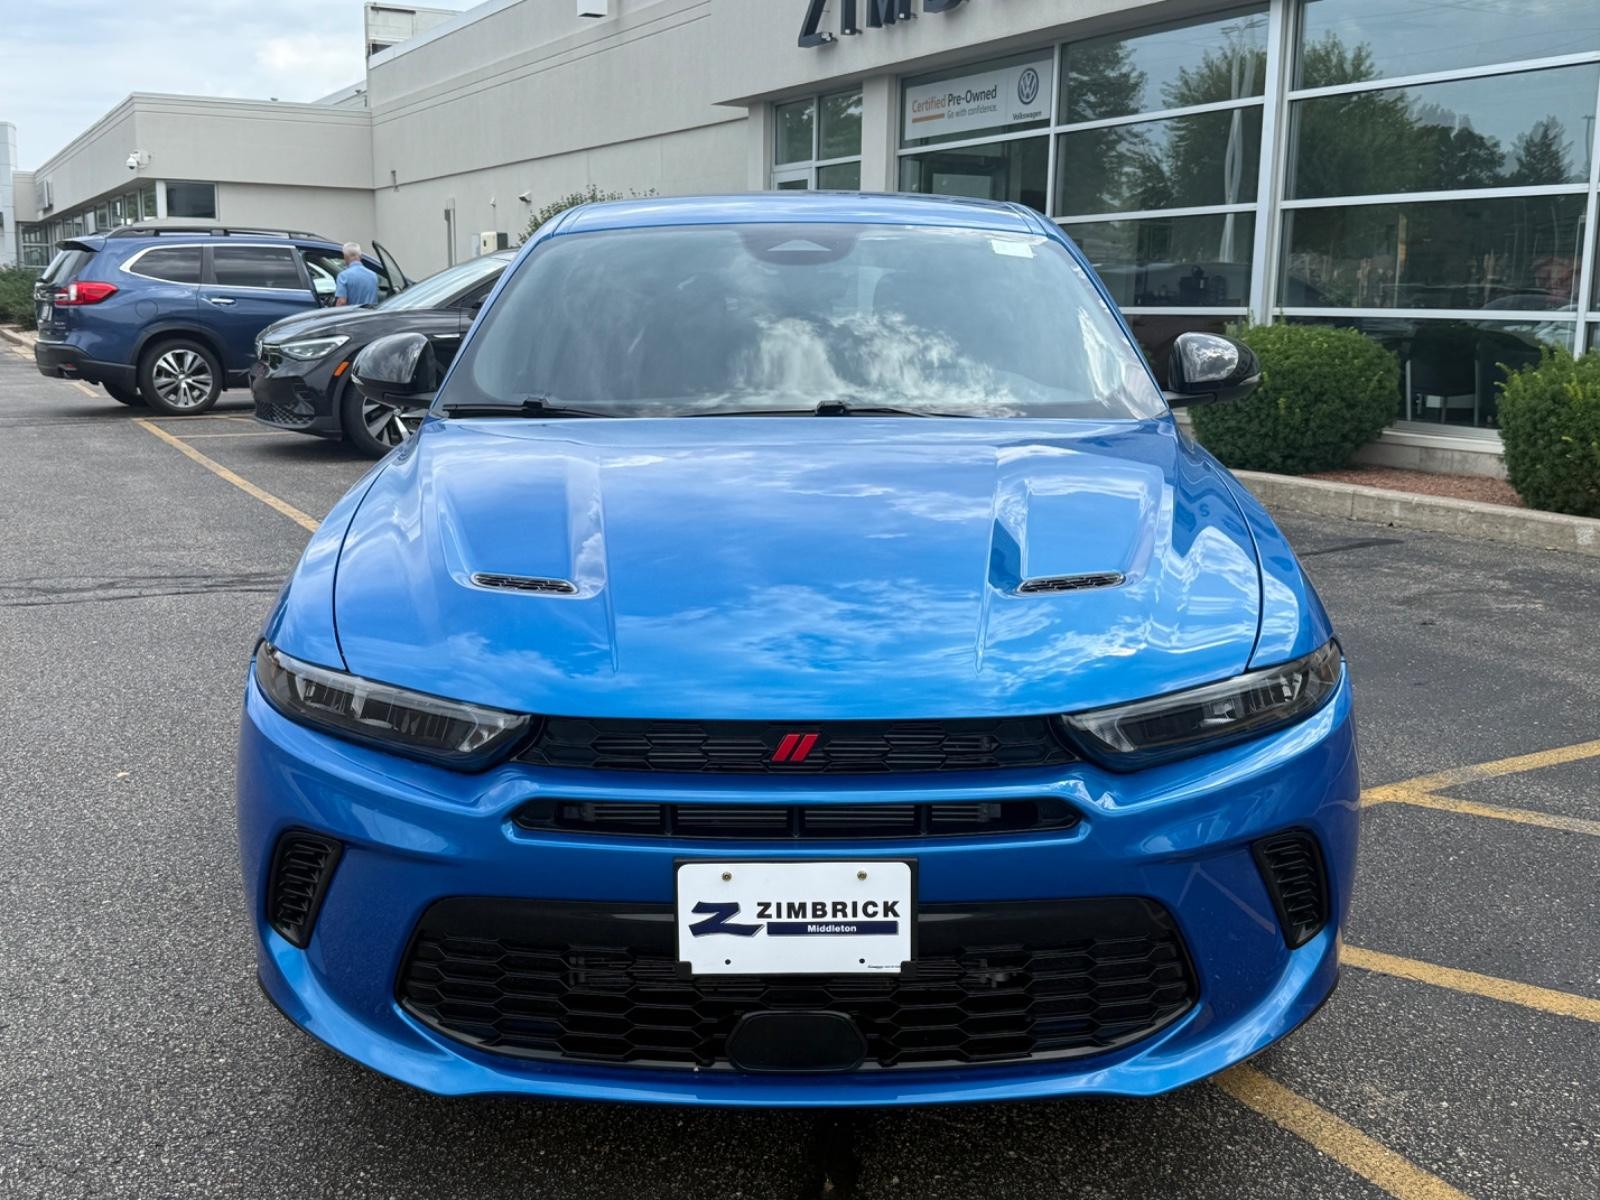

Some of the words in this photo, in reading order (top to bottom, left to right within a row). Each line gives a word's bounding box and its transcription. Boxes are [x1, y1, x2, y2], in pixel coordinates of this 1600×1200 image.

[798, 0, 966, 47] ZIM
[912, 95, 946, 113] Certified
[947, 85, 997, 107] Pre-Owned
[1012, 111, 1042, 120] Volkswagen
[757, 901, 900, 919] ZIMBRICK
[807, 924, 857, 933] Middleton
